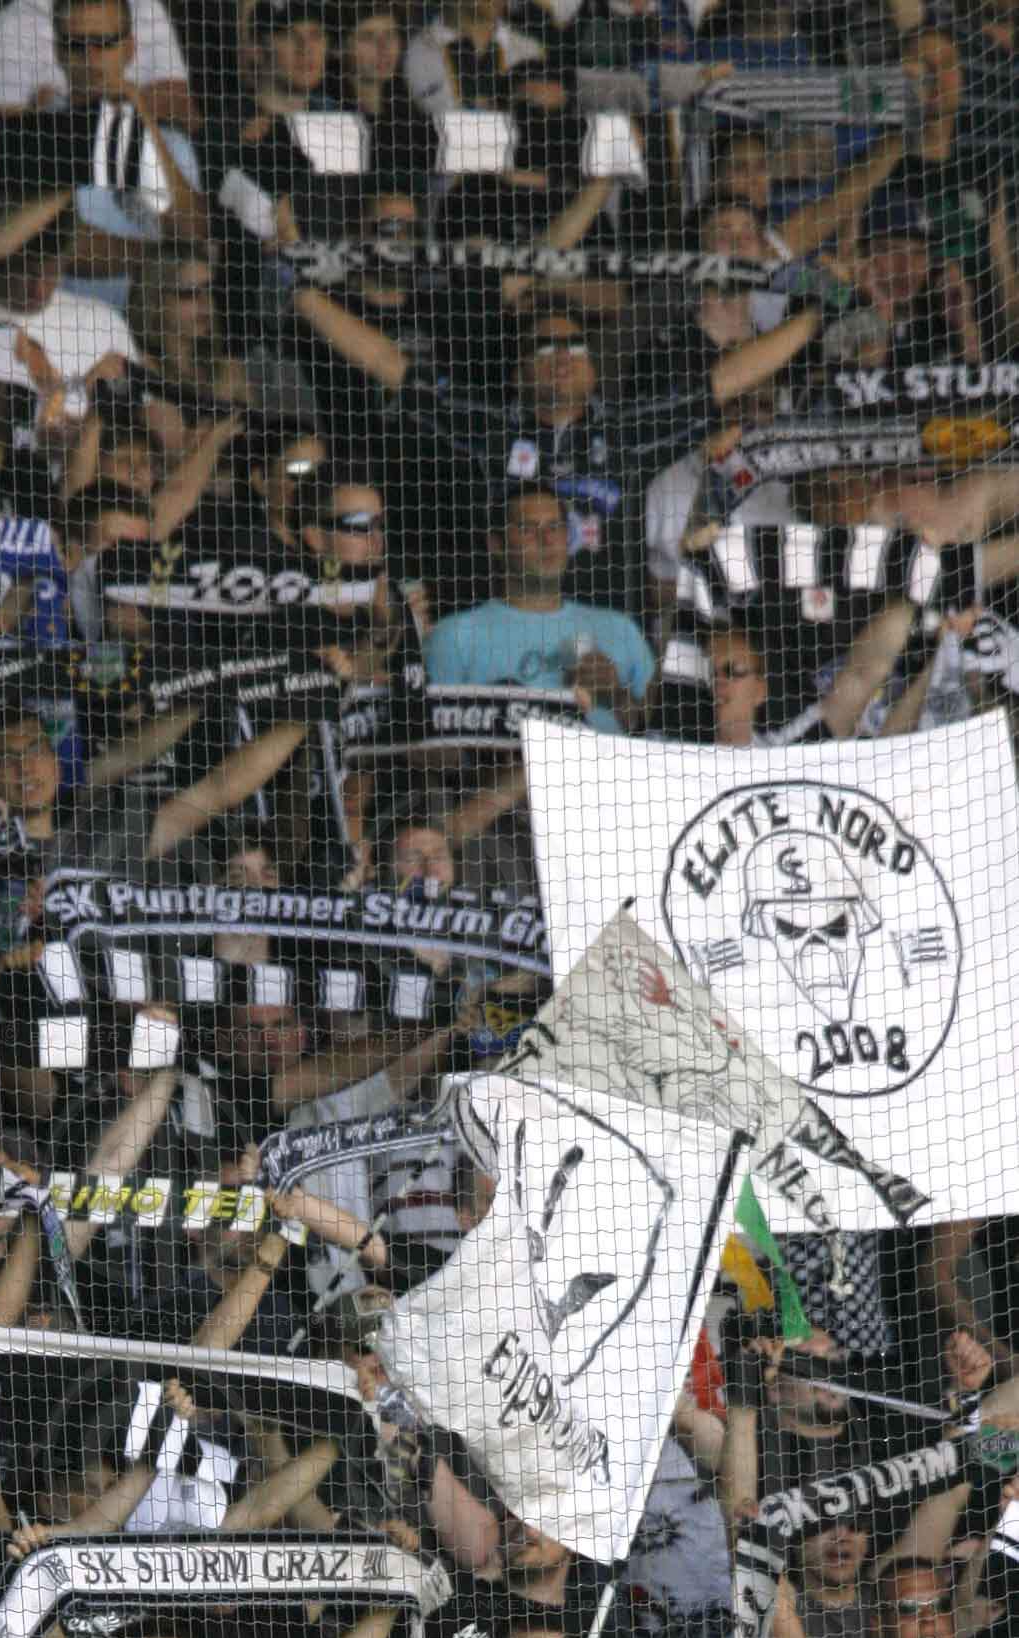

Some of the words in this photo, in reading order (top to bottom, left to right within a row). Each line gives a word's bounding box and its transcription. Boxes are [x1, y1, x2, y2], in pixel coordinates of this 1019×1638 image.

[682, 793, 790, 899] ELITE
[818, 795, 916, 877] NORD
[106, 884, 354, 924] Puntigamer
[364, 893, 493, 936] Sturm
[797, 1027, 910, 1080] 2008
[762, 1488, 820, 1537] SK
[810, 1441, 959, 1516] STURM
[73, 1552, 121, 1584] SK
[128, 1550, 247, 1583] STURM
[257, 1549, 344, 1583] GRAZ
